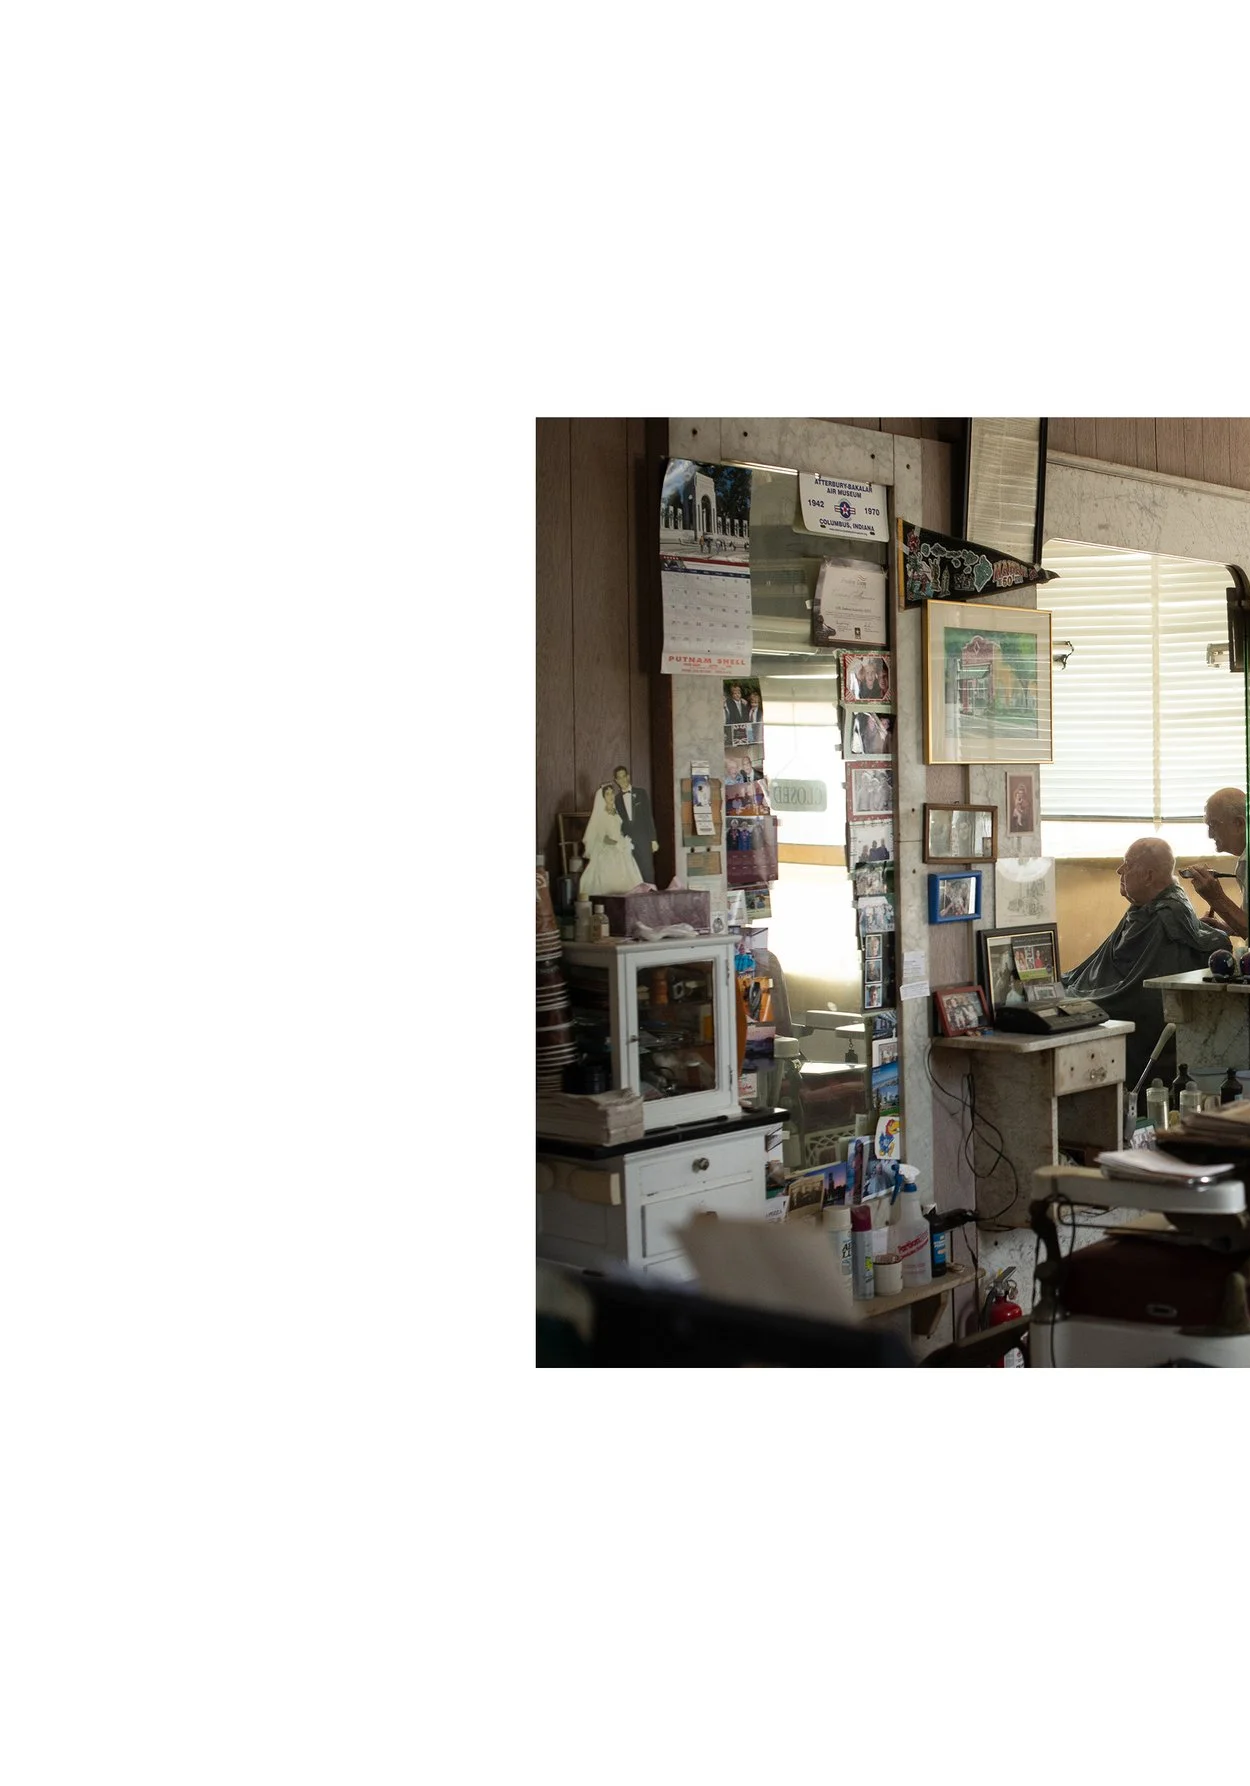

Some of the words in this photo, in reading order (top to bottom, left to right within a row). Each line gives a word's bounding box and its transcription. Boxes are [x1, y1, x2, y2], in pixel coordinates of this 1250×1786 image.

[814, 479, 873, 493] ATTERBURY-BAKALAR
[837, 489, 862, 498] MUSEUM
[808, 499, 825, 508] 1942
[864, 507, 880, 516] 1970
[819, 518, 852, 529] COLUMBUS,
[852, 523, 875, 531] INDIANA
[668, 655, 712, 664] PUTNAM
[717, 657, 746, 666] SHELL
